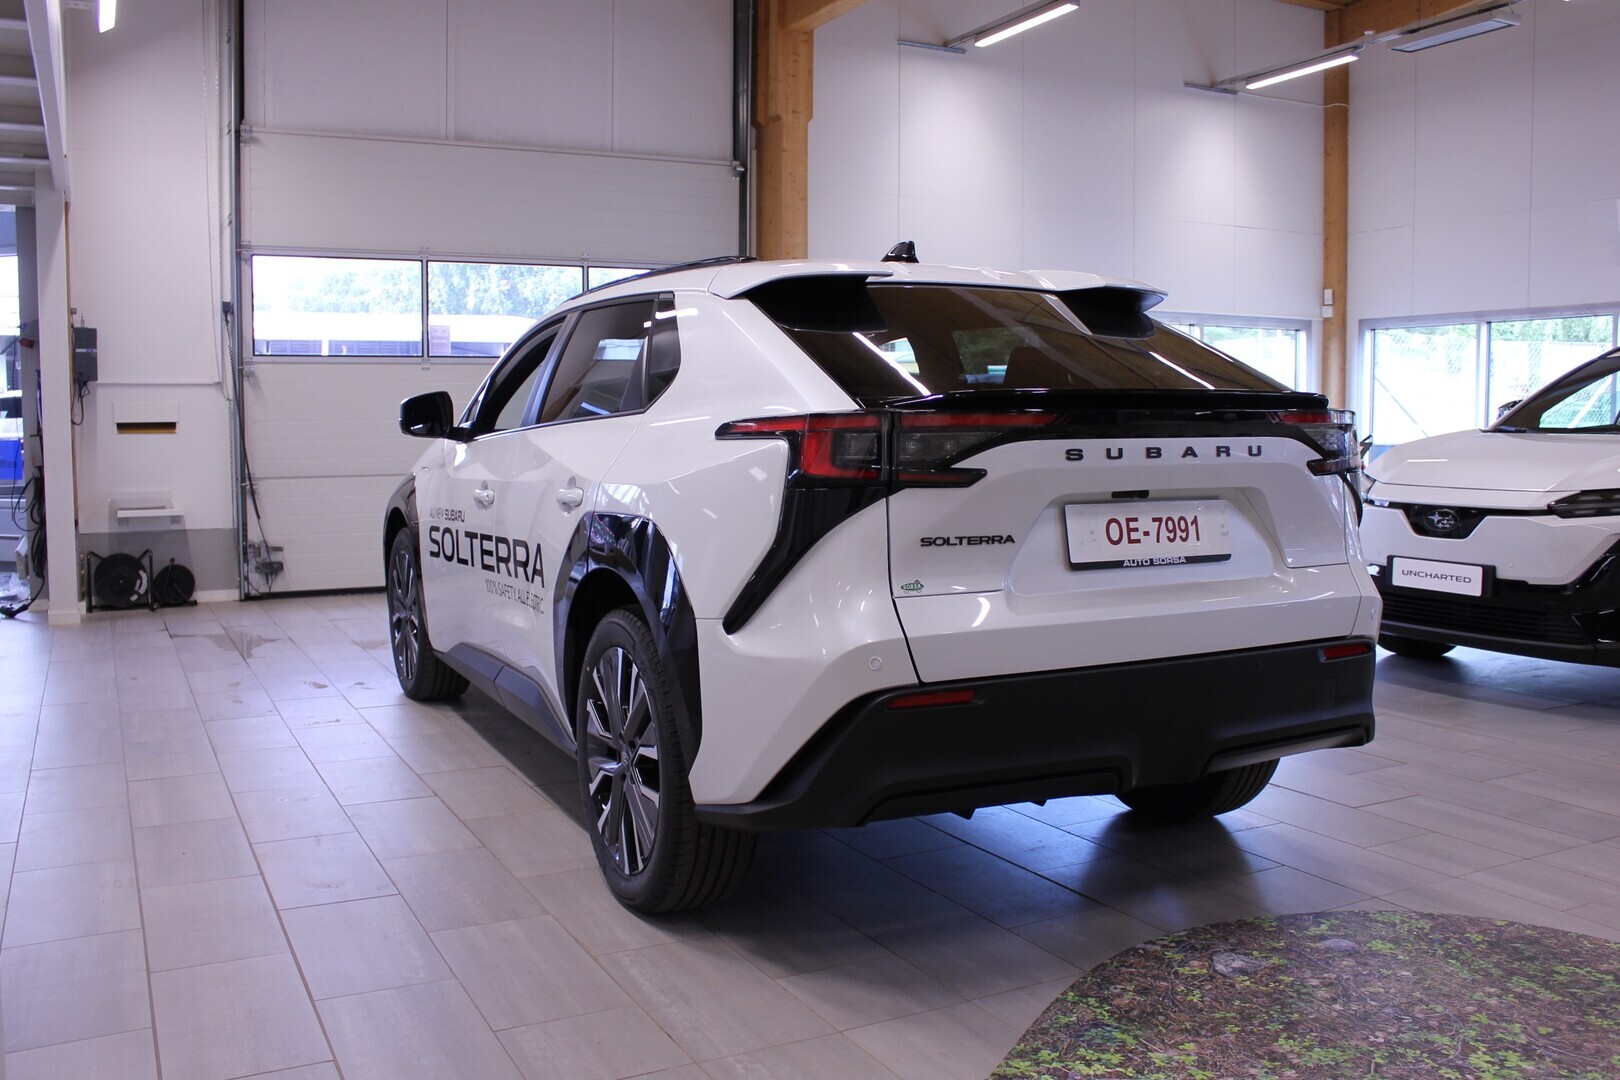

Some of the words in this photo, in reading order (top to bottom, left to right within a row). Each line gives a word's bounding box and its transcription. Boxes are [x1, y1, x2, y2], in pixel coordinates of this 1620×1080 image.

[1065, 445, 1262, 461] SUBARU
[444, 508, 465, 523] SUBARU
[1105, 515, 1200, 546] OE-7991
[920, 534, 1015, 547] SOLTERRA
[428, 525, 545, 589] SOLTERRA
[1123, 558, 1150, 568] AUTO
[1153, 556, 1187, 566] SORSA
[1401, 569, 1472, 584] UNCHARTED
